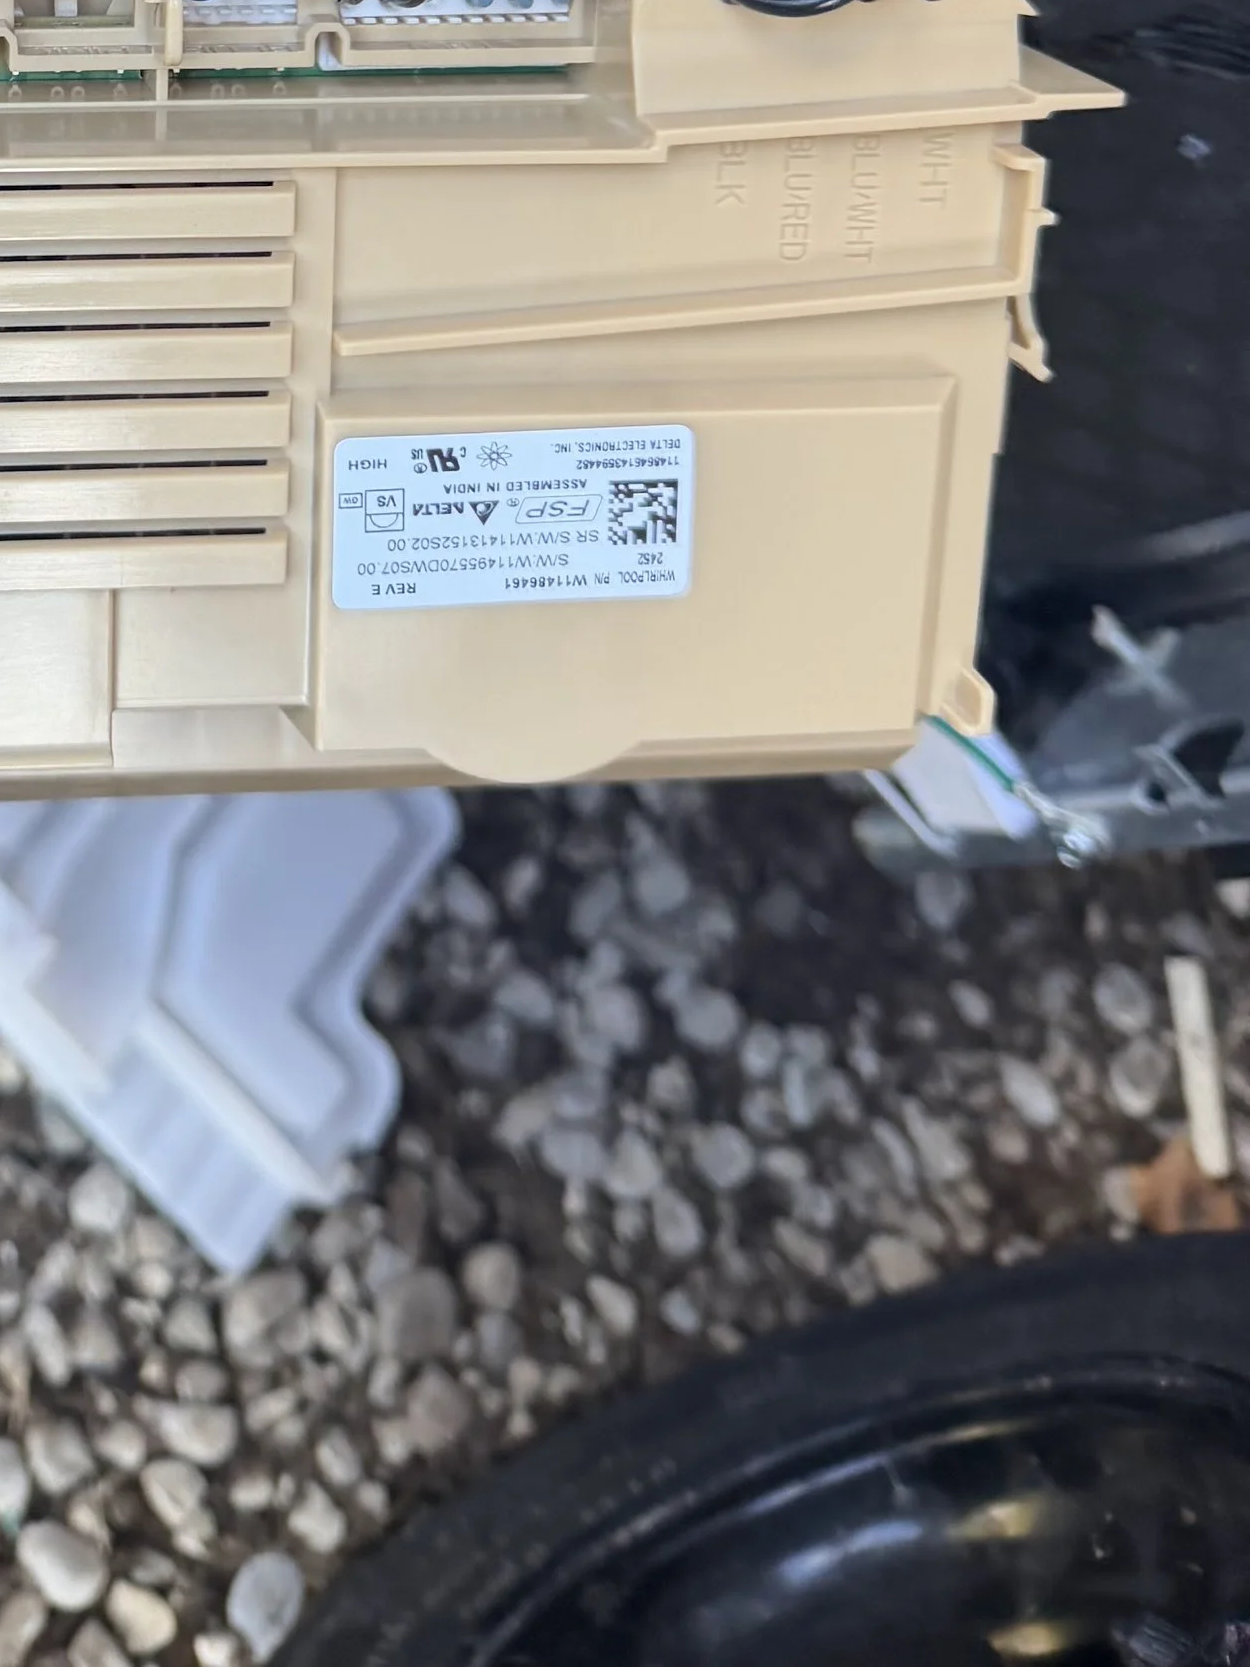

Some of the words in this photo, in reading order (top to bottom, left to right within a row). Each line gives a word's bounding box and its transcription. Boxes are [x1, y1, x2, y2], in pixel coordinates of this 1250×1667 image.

[715, 142, 747, 208] BLK
[918, 132, 953, 209] WHT
[780, 139, 815, 261] BLU/RED
[843, 135, 881, 263] BLU/WHT
[550, 442, 572, 454] INC.
[650, 438, 681, 450] DELTA
[348, 459, 387, 470] HIGH
[443, 483, 481, 494] INDIA
[486, 482, 500, 493] IN
[506, 478, 588, 492] ASSEMBLED
[376, 495, 397, 508] VS
[412, 502, 464, 516] DELTA
[525, 500, 590, 518] FSP
[576, 529, 599, 543] SR
[637, 552, 663, 565] 2452
[504, 574, 587, 590] W11486461
[594, 572, 610, 585] P/N
[618, 570, 676, 584] WHIRLPOOL
[371, 584, 380, 596] E
[386, 583, 416, 595] REV
